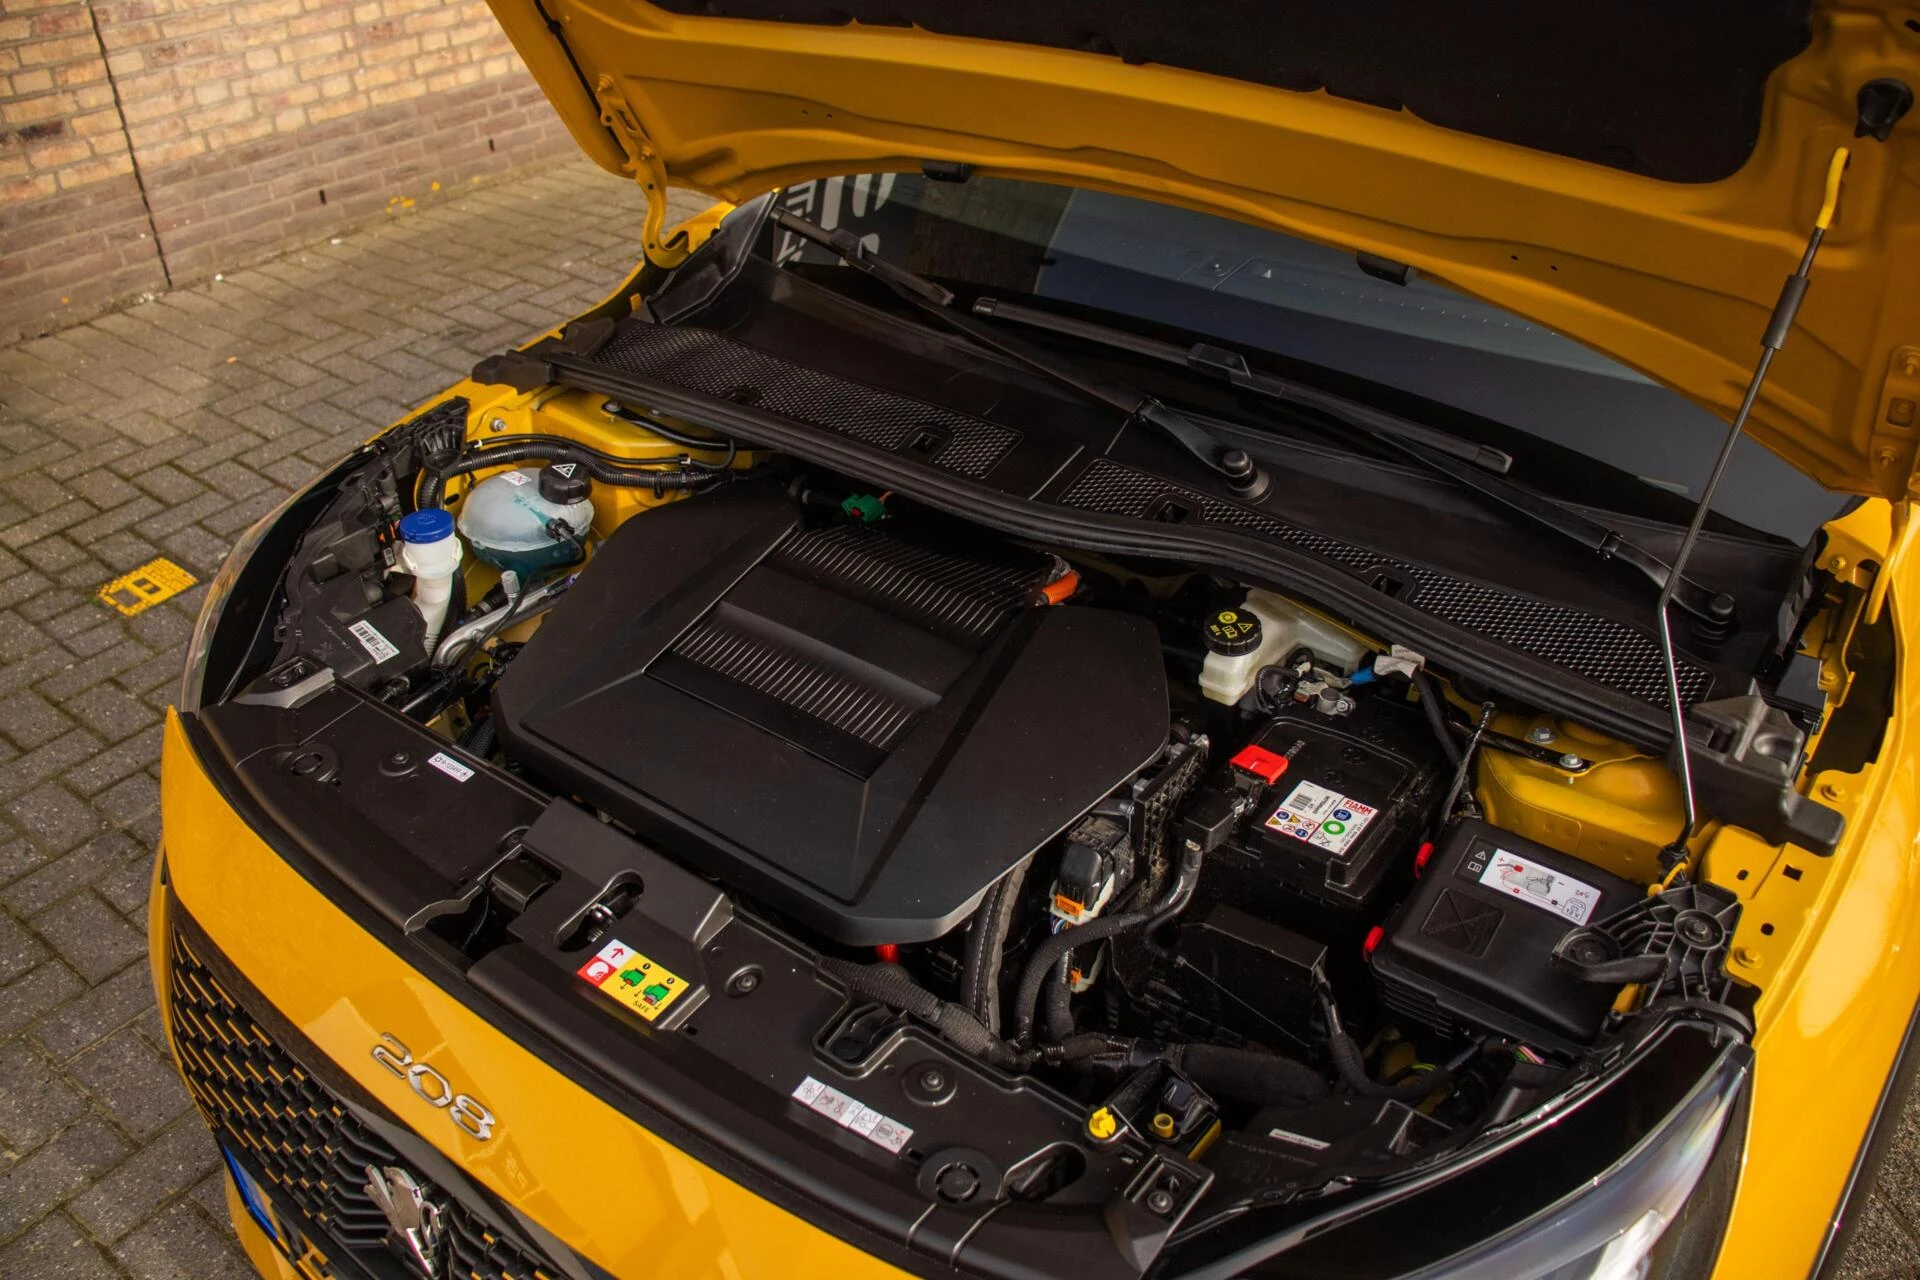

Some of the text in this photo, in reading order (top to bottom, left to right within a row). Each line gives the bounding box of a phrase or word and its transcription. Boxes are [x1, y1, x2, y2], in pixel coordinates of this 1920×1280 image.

[1343, 800, 1372, 814] FIAMM
[633, 1000, 651, 1013] SAFE
[371, 1031, 496, 1141] 208
